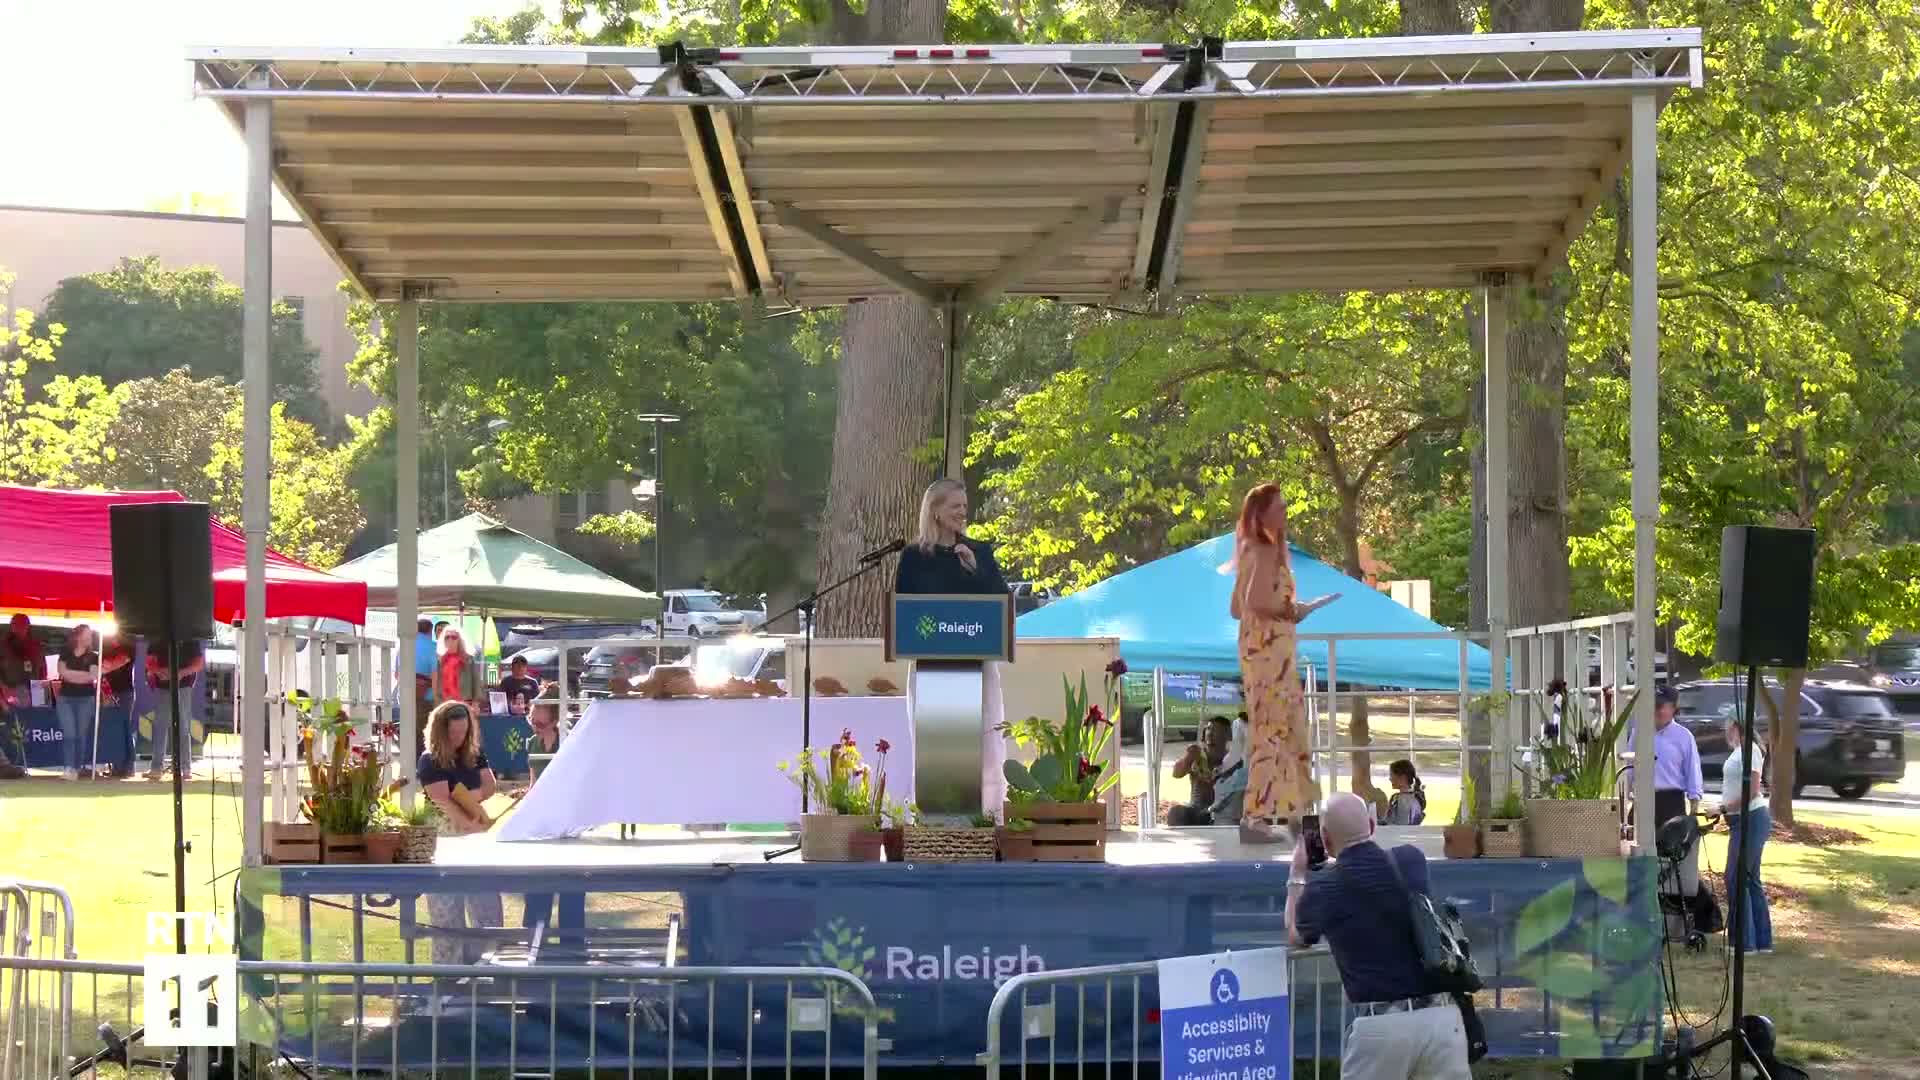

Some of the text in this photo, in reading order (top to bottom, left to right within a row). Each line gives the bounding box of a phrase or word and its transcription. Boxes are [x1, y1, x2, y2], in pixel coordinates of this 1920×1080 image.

[938, 621, 983, 636] Raleigh
[32, 728, 63, 741] Rale
[886, 944, 1046, 989] Raleigh
[1182, 1011, 1271, 1039] Accessiblity
[1188, 1039, 1265, 1064] Services &
[1243, 1065, 1276, 1080] Area
